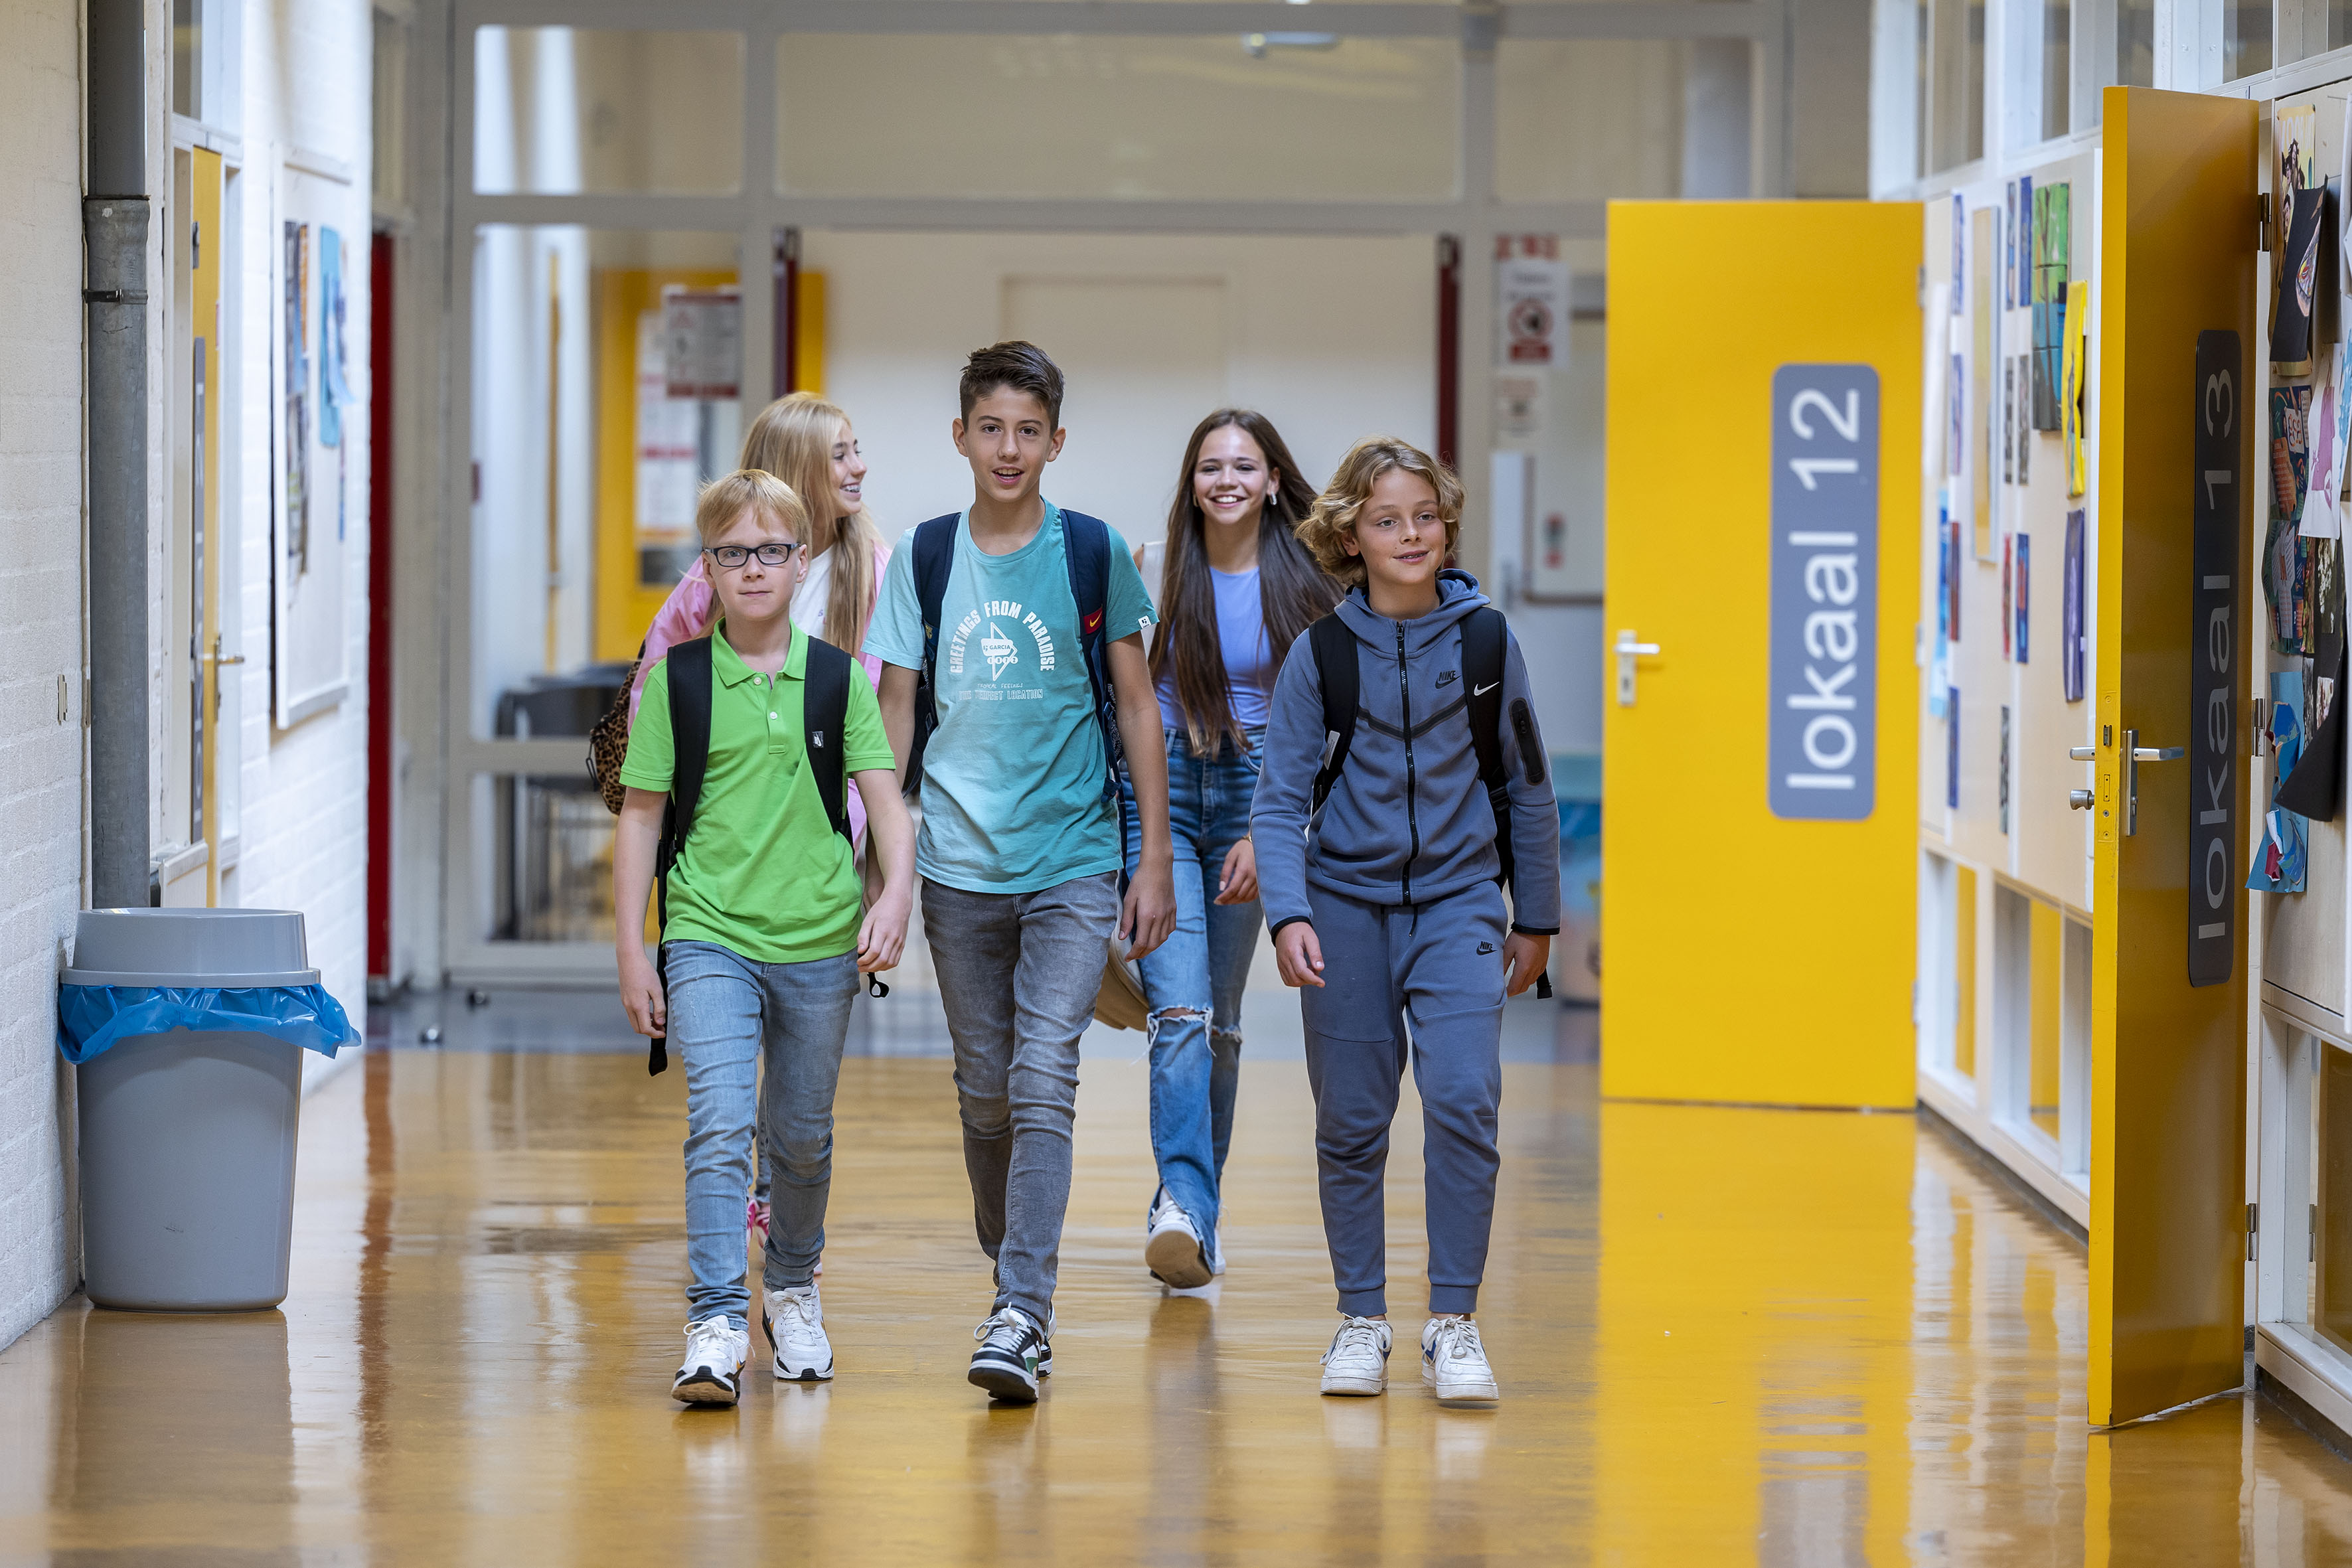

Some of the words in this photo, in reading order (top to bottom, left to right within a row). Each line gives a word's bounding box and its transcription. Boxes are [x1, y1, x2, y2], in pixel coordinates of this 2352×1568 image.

[1788, 388, 1859, 491] 12
[2204, 368, 2233, 510] 13
[950, 609, 981, 673] GREETINGS
[984, 600, 1022, 619] FROM
[1022, 611, 1055, 671] PARADISE
[1439, 670, 1456, 681] NIKE
[1786, 532, 1859, 790] lokaal
[1007, 689, 1043, 700] LOCATION
[2198, 575, 2231, 939] lokaal
[1480, 941, 1493, 951] NIKE
